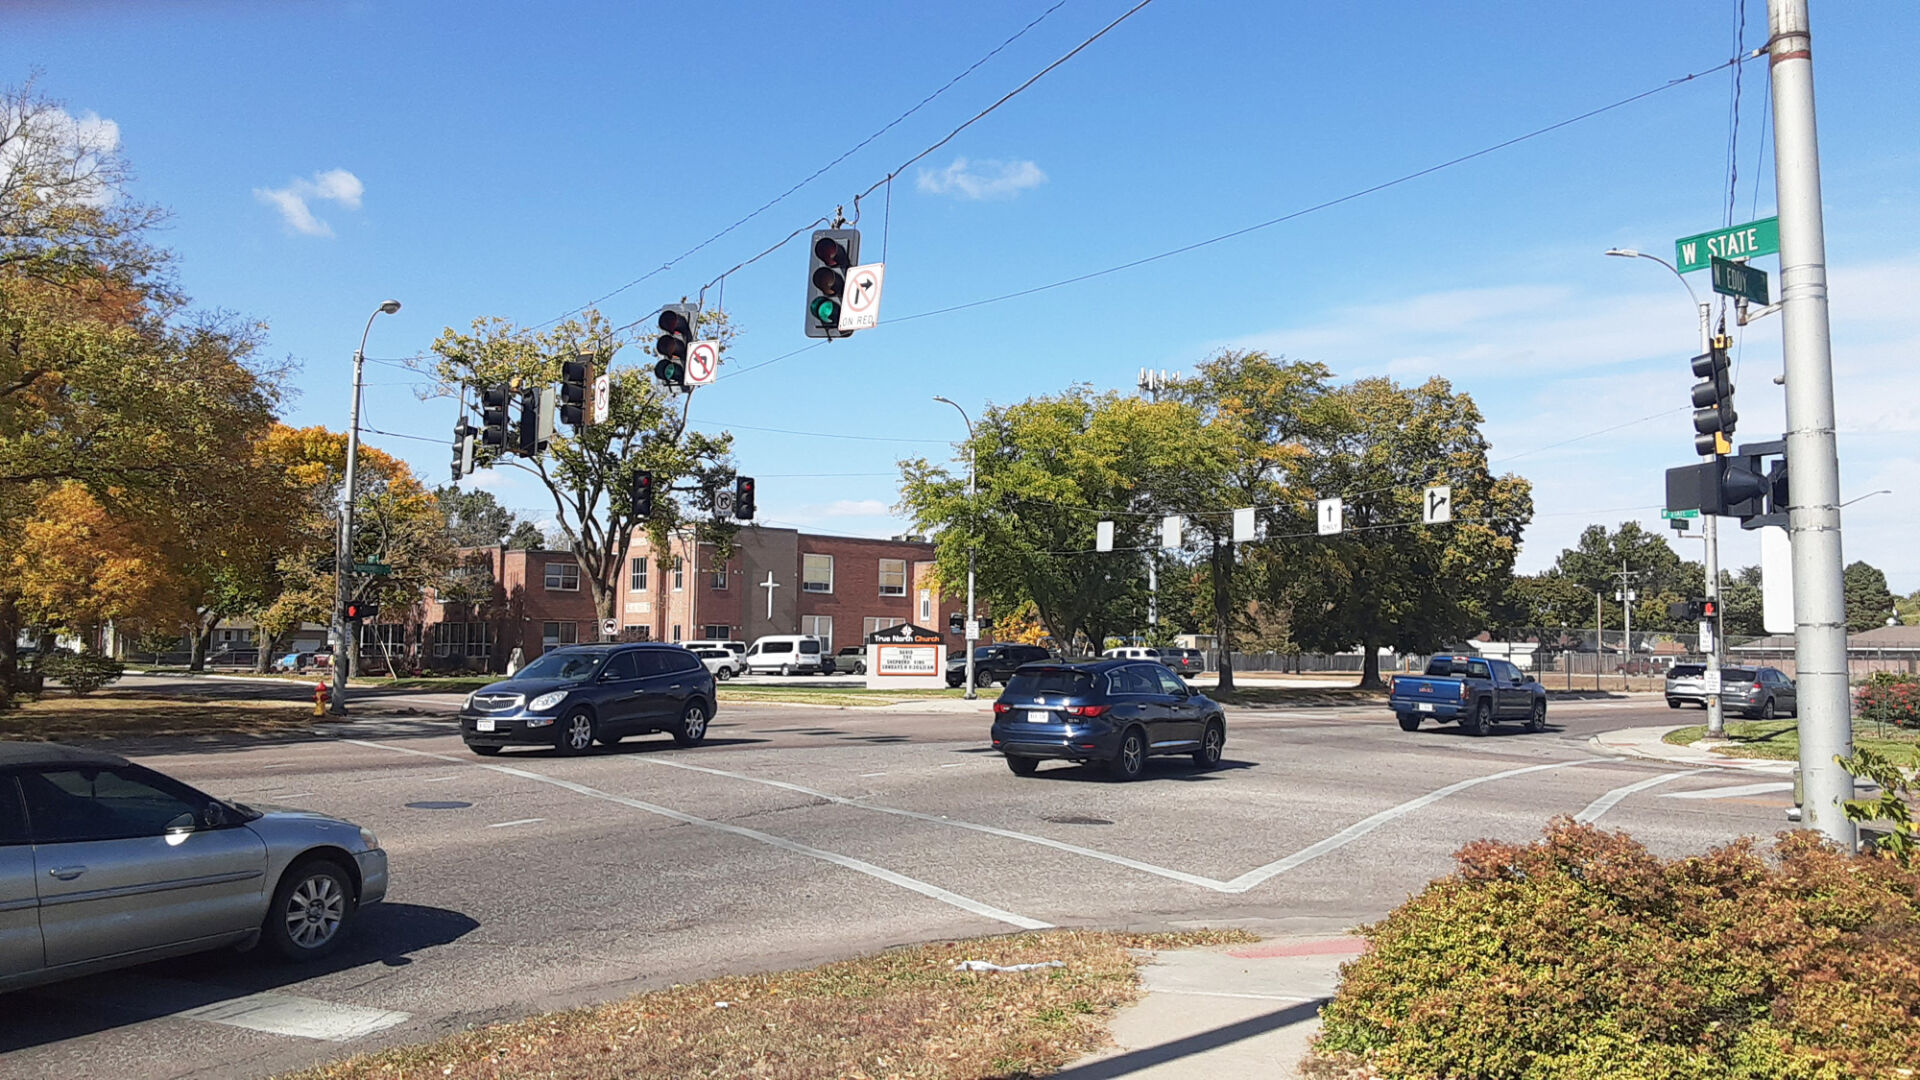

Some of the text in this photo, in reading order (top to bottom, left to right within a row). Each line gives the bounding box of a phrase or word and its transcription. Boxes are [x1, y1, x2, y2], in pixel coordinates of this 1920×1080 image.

[1682, 228, 1759, 265] W STATE
[1713, 263, 1748, 293] N EDDY
[842, 315, 875, 327] ON RED
[1321, 523, 1339, 532] ONLY
[892, 634, 914, 642] North
[914, 635, 940, 643] Church
